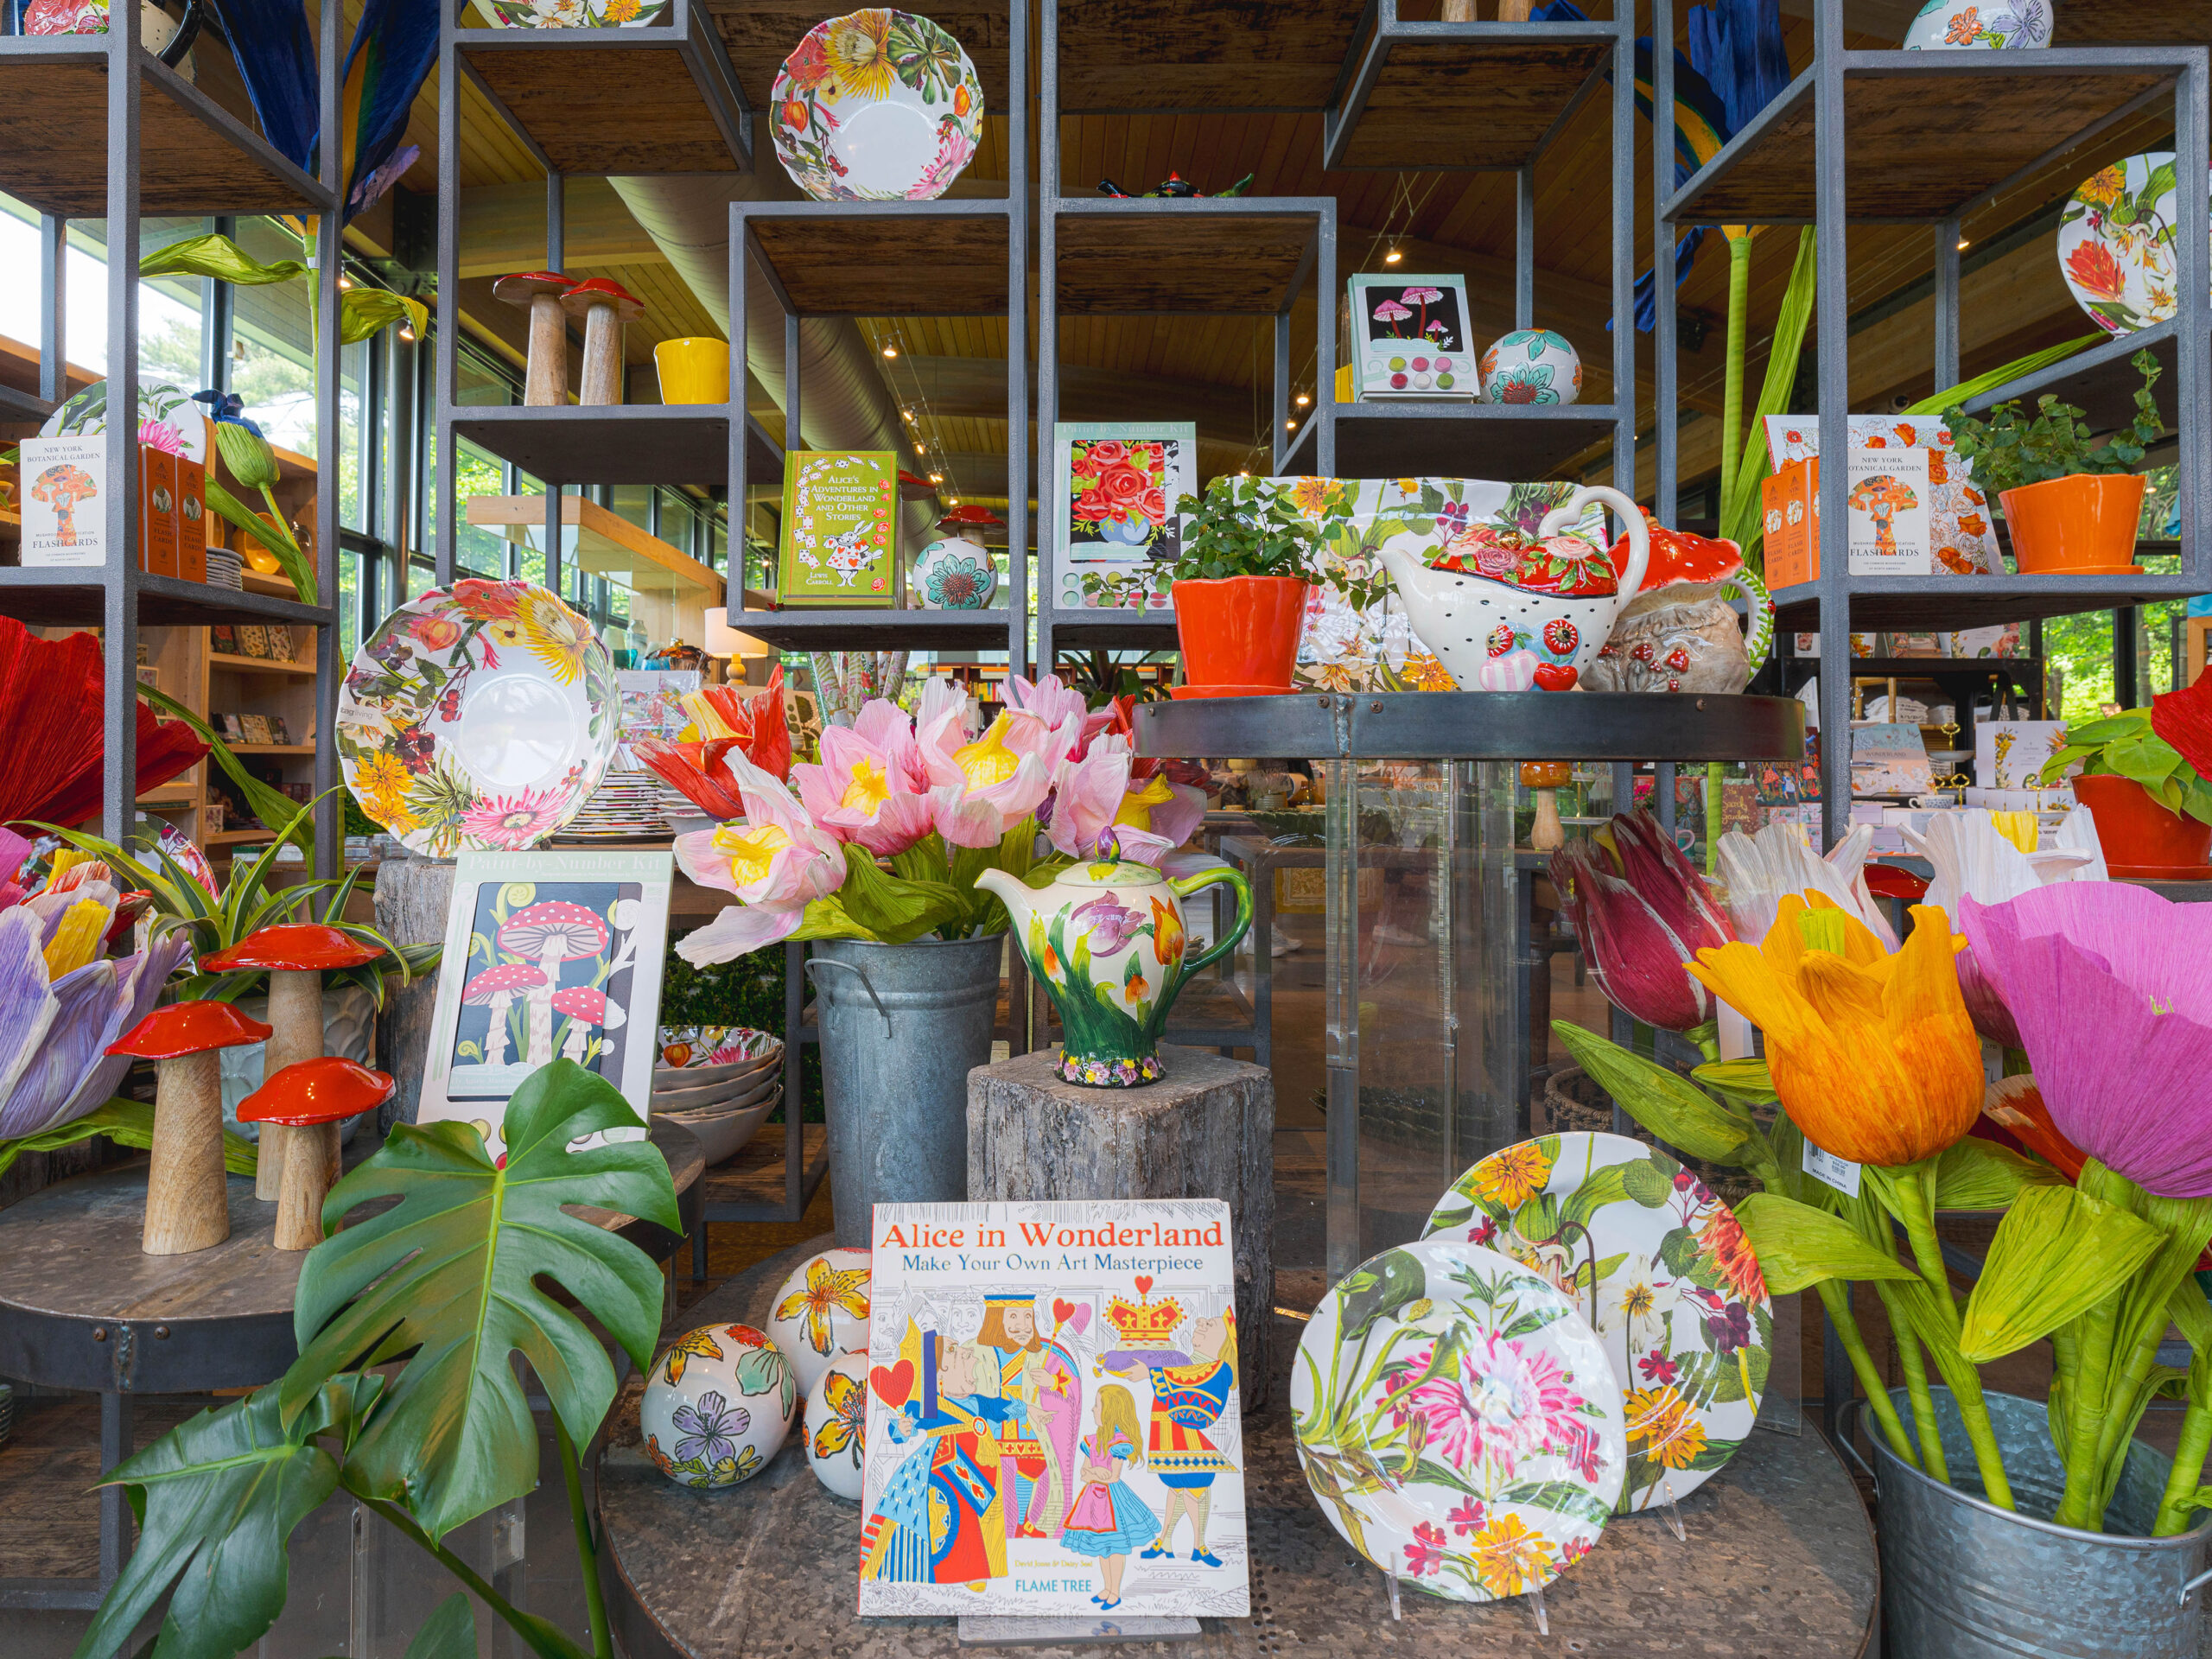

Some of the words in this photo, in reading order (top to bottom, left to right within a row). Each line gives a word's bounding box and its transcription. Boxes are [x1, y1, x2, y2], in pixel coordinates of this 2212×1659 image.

[1169, 423, 1188, 433] Kit
[27, 454, 69, 463] BOTANICAL
[70, 452, 101, 461] GARDEN
[811, 485, 868, 493] ADVENTURES
[813, 493, 876, 502] WONDERLAND
[836, 503, 869, 512] OTHER
[825, 512, 862, 521] STORIES
[33, 537, 99, 549] FLASHCARDS
[1849, 548, 1920, 556] FLASHCARDS
[355, 709, 373, 720] living
[633, 855, 661, 870] Kit
[1812, 1167, 1826, 1179] MADE
[1831, 1178, 1847, 1190] CHINA
[880, 1224, 964, 1249] Alice
[976, 1224, 1007, 1248] in
[1018, 1221, 1224, 1247] Wonderland
[902, 1254, 951, 1271] Make
[957, 1254, 1001, 1271] Your
[1006, 1253, 1051, 1271] Own
[1057, 1253, 1087, 1270] Art
[1094, 1253, 1204, 1274] Masterpiece
[1014, 1559, 1033, 1567] David
[1015, 1579, 1058, 1592] FLAME
[1061, 1579, 1092, 1592] TREE
